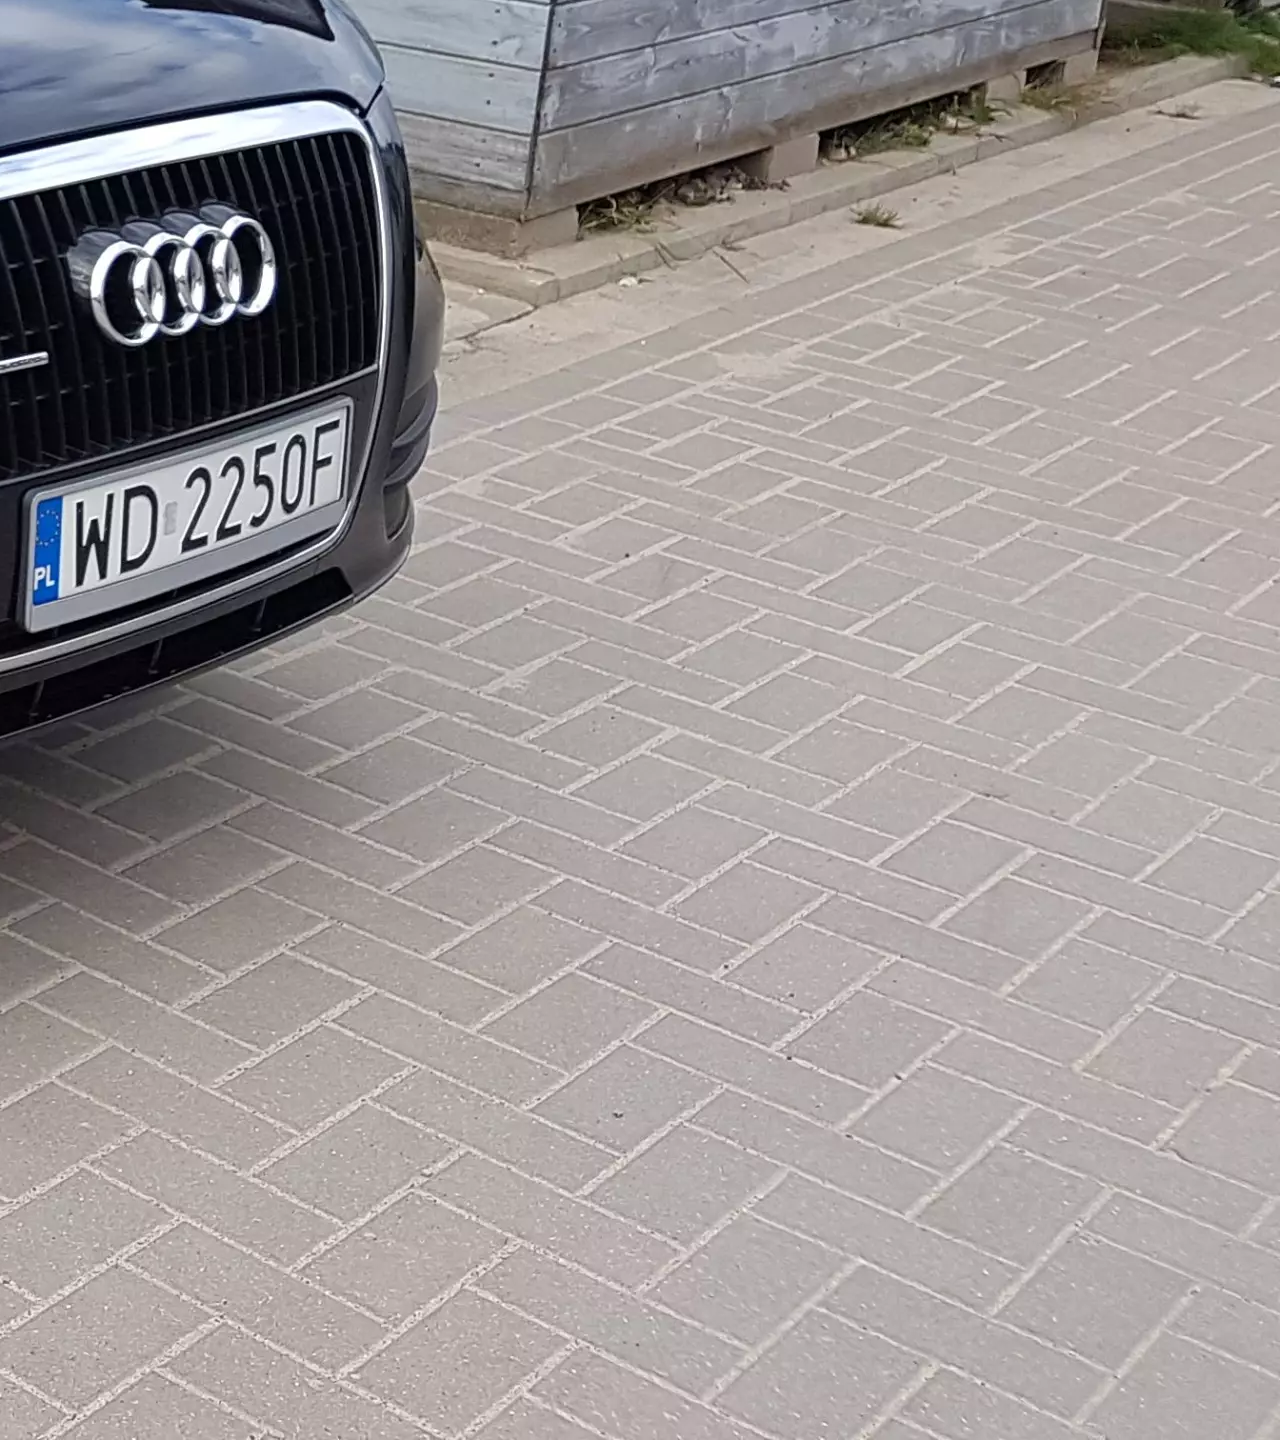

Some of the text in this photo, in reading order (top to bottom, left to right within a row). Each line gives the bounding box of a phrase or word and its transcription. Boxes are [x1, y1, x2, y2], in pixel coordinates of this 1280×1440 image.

[74, 419, 341, 588] WD 2250F
[34, 564, 56, 591] PL
